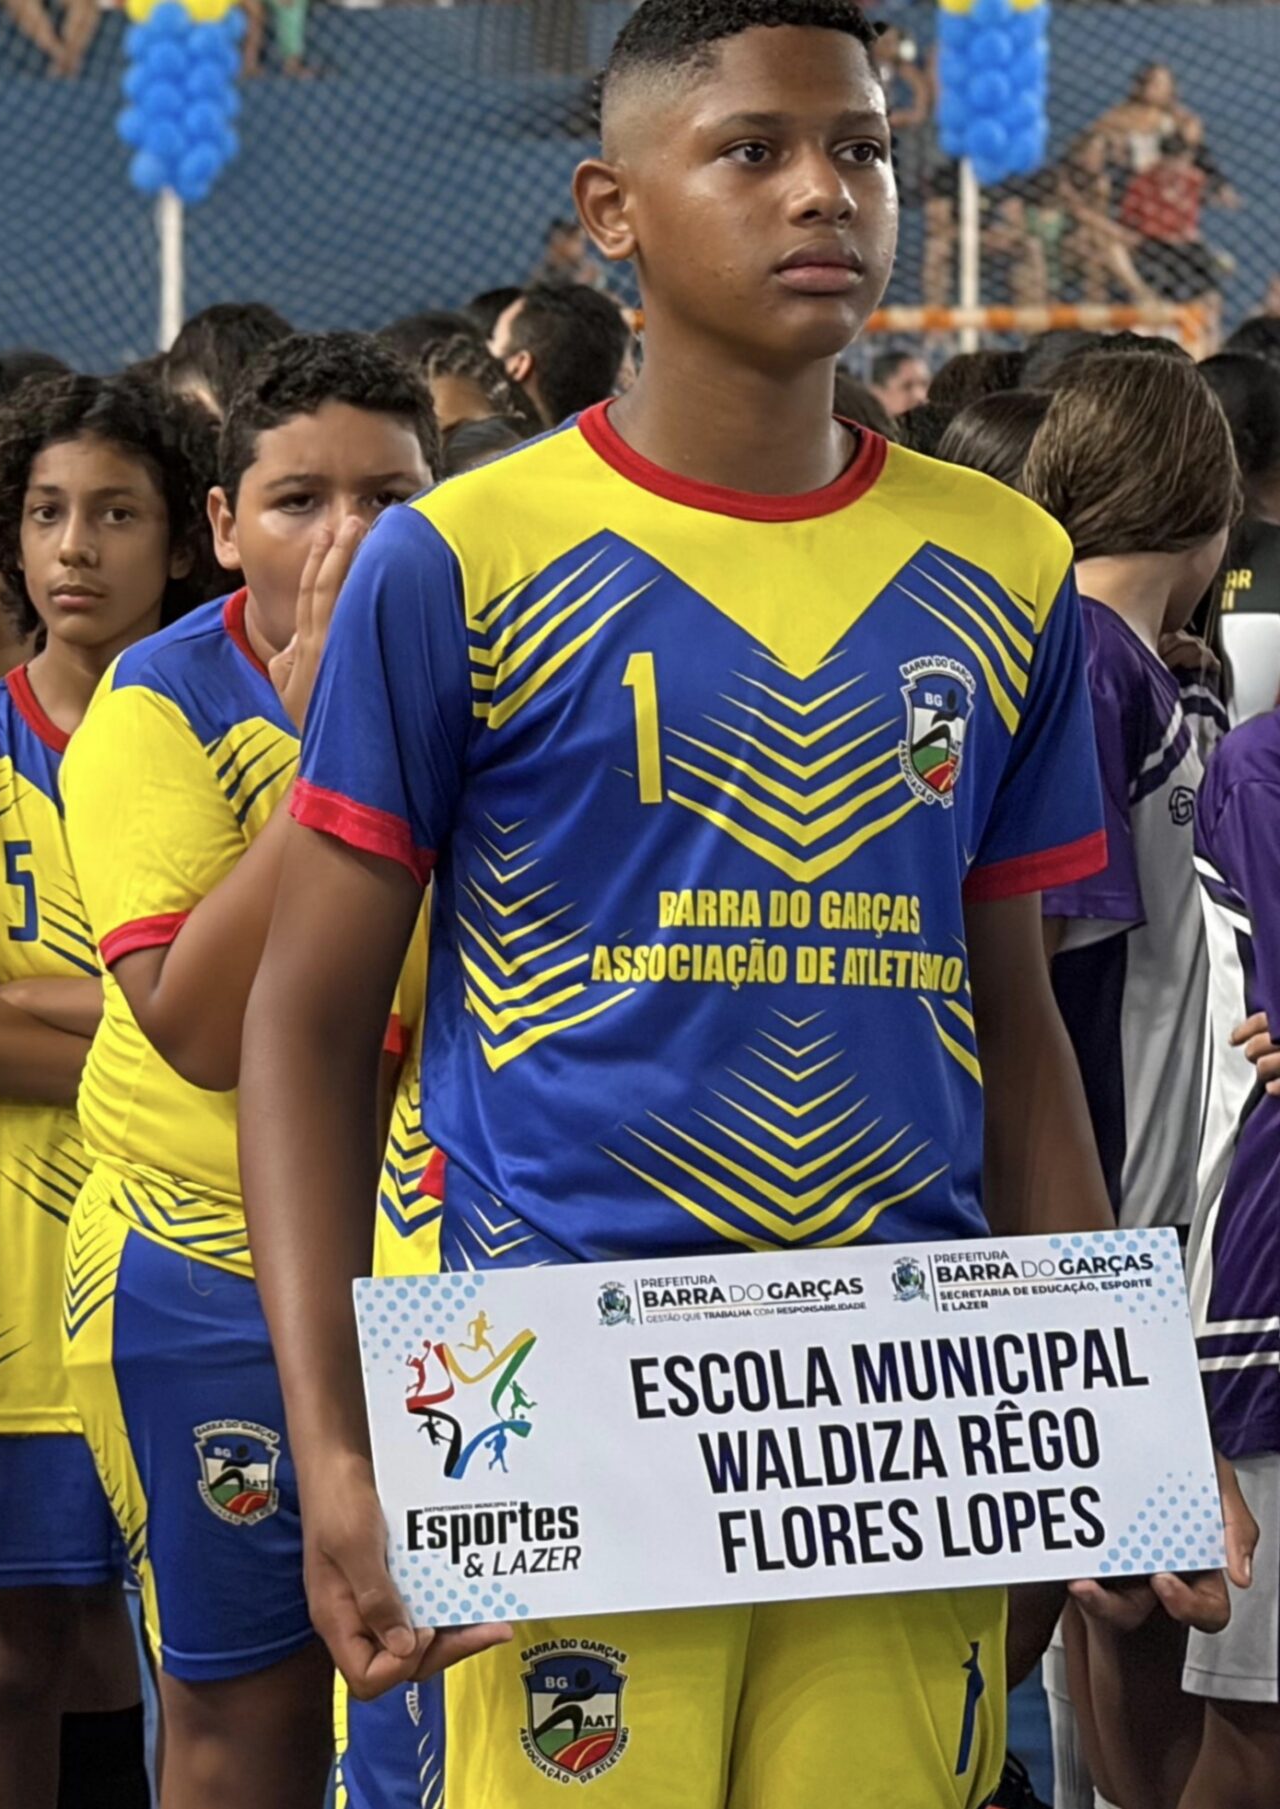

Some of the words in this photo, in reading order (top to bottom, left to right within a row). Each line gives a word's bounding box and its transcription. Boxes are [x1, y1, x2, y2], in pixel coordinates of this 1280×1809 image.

[925, 692, 942, 706] BG
[621, 652, 664, 804] 1
[3, 840, 39, 942] 5
[658, 889, 763, 929] BARRA
[768, 890, 811, 929] DO
[820, 891, 920, 939] GARÇAS
[591, 938, 788, 991] ASSOCIAÇÃO
[795, 946, 836, 985] DE
[842, 947, 963, 994] ATLETISMO
[934, 1250, 1009, 1264] PREFEITURA
[936, 1262, 1019, 1283] BARRA
[1021, 1259, 1056, 1279] DO
[1058, 1253, 1154, 1278] GARÇAS
[641, 1274, 717, 1288] PREFEITURA
[643, 1287, 727, 1308] BARRA
[728, 1283, 764, 1303] DO
[767, 1277, 864, 1302] GARÇAS
[939, 1288, 1011, 1301] SECRETARIA
[1013, 1286, 1029, 1297] DE
[1031, 1281, 1099, 1296] EDUCAÇÃO,
[1100, 1278, 1153, 1291] ESPORTE
[646, 1311, 682, 1324] GESTÃO
[682, 1311, 702, 1322] QUE
[703, 1309, 752, 1320] TRABALHA
[753, 1307, 775, 1318] COM
[776, 1301, 867, 1316] RESPONSABILIDADE
[941, 1302, 949, 1312] E
[951, 1300, 989, 1311] LAZER
[629, 1346, 842, 1419] ESCOLA
[851, 1327, 1150, 1404] MUNICIPAL
[697, 1417, 948, 1494] WALDIZA
[958, 1399, 1100, 1477] RÊGO
[407, 1501, 580, 1565] Esportes
[718, 1498, 923, 1574] FLORES
[936, 1485, 1106, 1558] LOPES
[463, 1552, 484, 1579] &
[492, 1546, 582, 1576] LAZER
[521, 1641, 559, 1661] BARRA
[560, 1639, 577, 1649] DO
[581, 1639, 627, 1663] GARÇAS
[545, 1676, 568, 1689] BG
[584, 1715, 614, 1727] AAT
[520, 1728, 570, 1784] ASSOCIAÇÃO
[579, 1771, 594, 1784] DE
